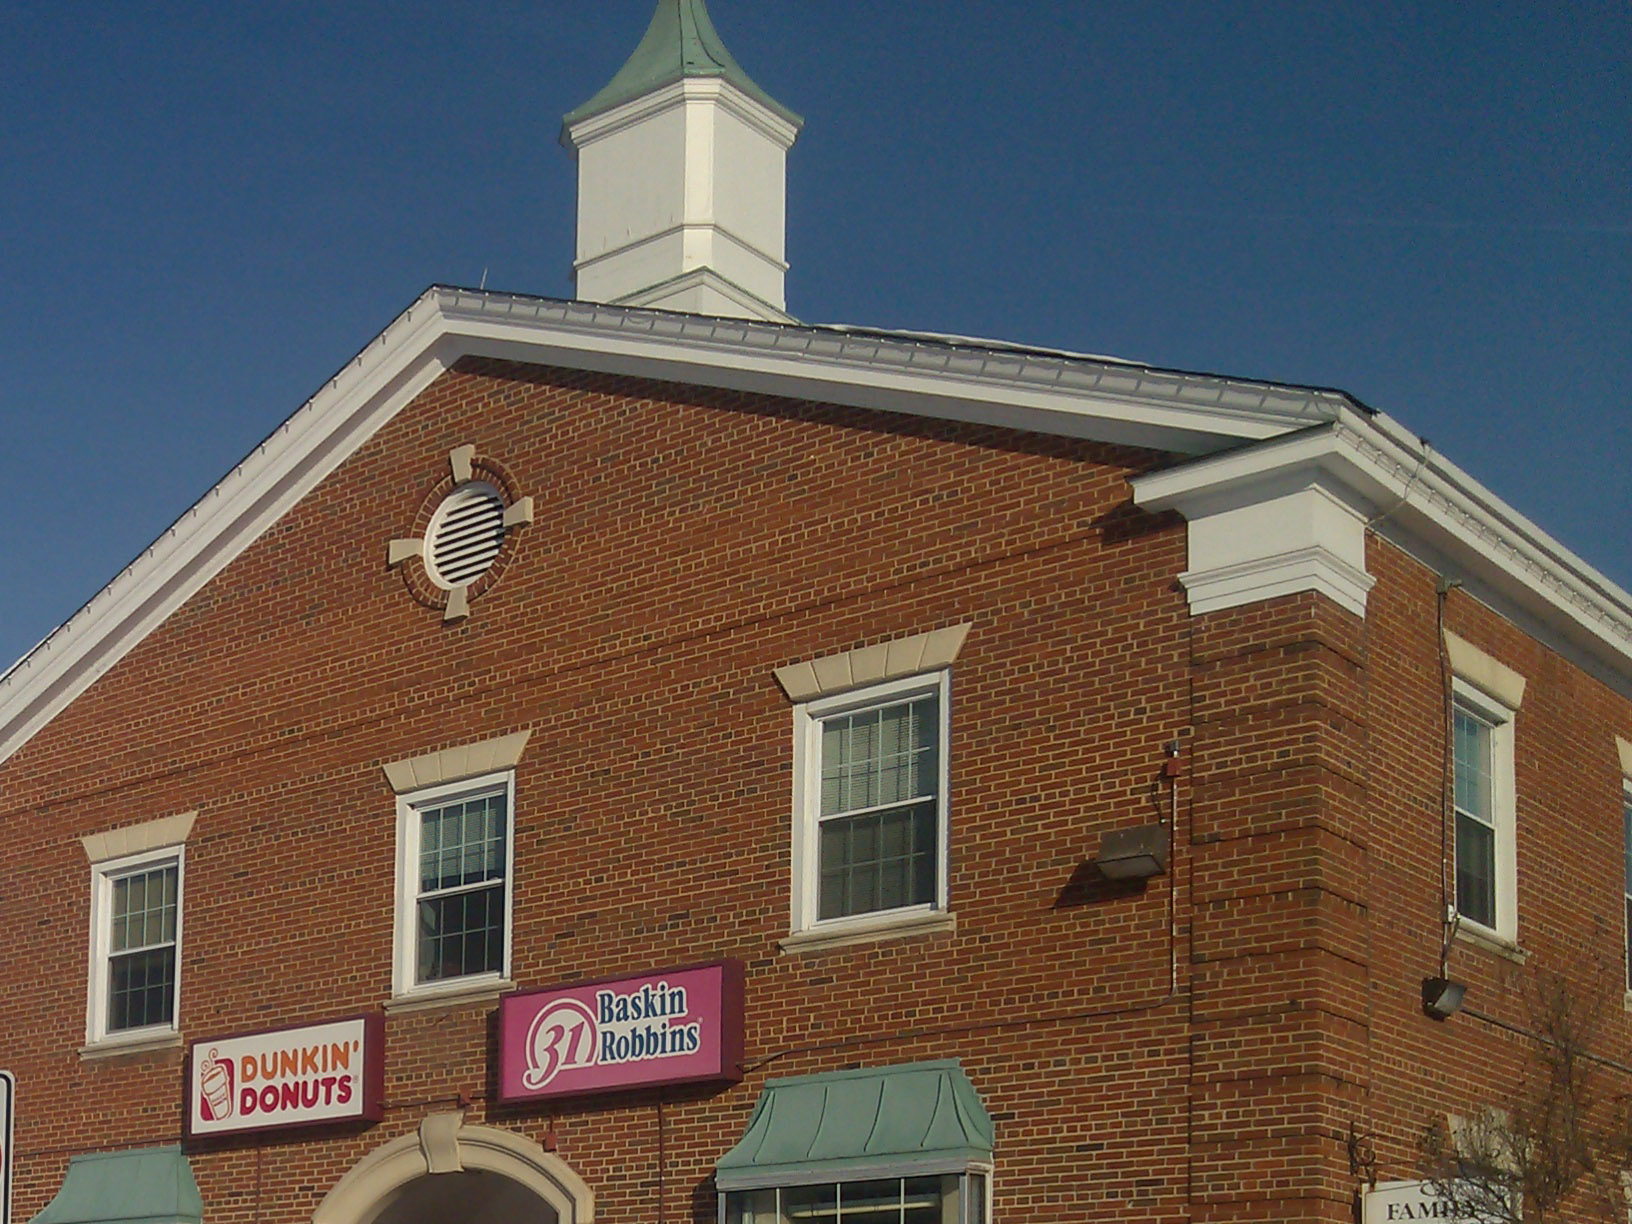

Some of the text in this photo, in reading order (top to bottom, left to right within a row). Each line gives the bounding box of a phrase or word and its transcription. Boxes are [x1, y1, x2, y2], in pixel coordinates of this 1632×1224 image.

[599, 984, 686, 1025] Baskin
[240, 1040, 359, 1083] DUNKIN'
[525, 1021, 585, 1085] 31
[600, 1022, 699, 1063] Robbins
[239, 1074, 353, 1116] DONUTS
